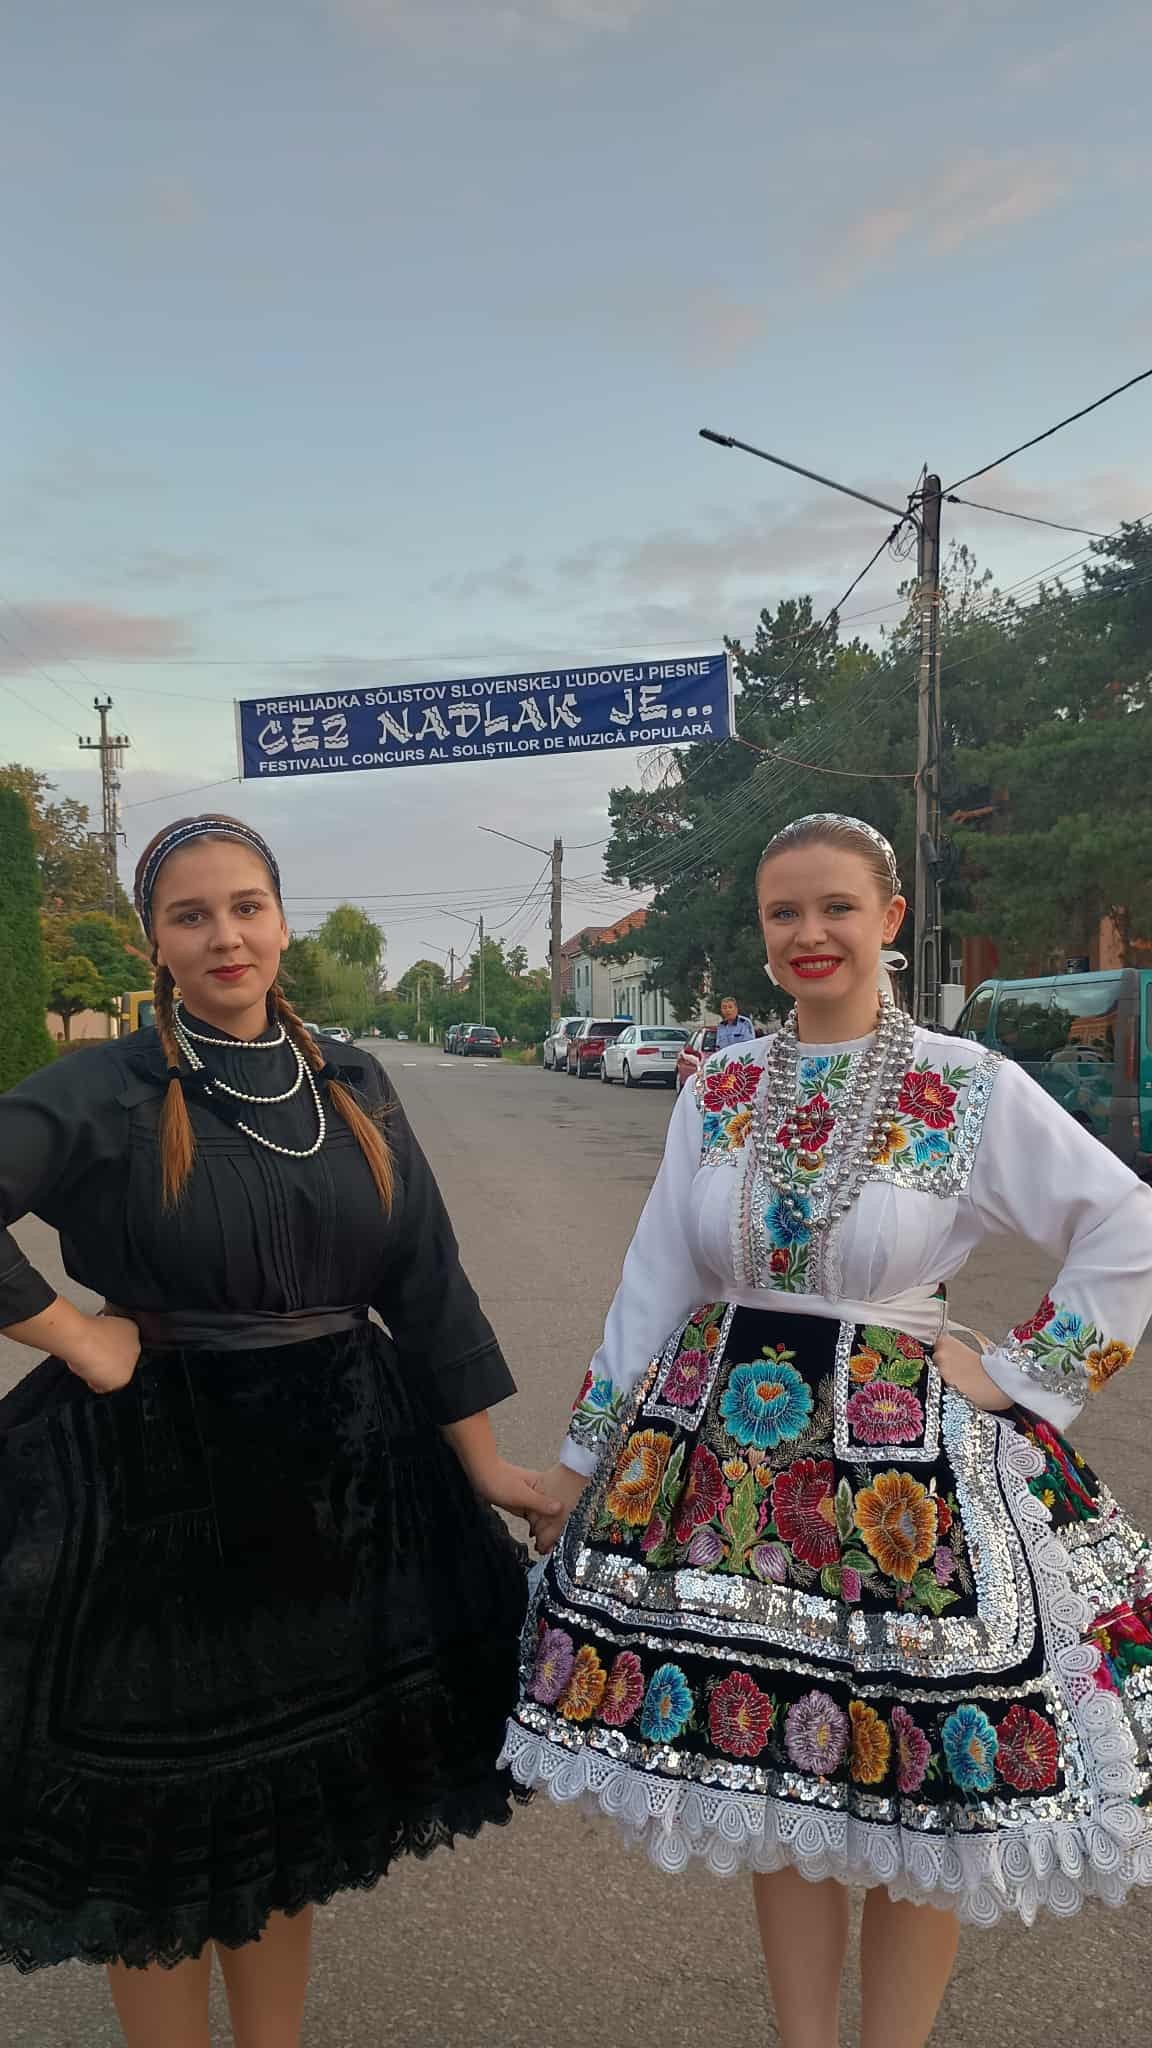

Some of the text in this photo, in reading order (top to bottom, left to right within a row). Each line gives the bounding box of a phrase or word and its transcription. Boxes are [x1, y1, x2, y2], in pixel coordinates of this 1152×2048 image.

[256, 694, 360, 716] PREHLIADKA
[451, 674, 561, 698] SLOVENSKEJ
[649, 660, 711, 680] PIESNE
[377, 693, 582, 745] NADLAK
[609, 684, 713, 726] JE...
[259, 754, 348, 773] FESTIVALUL
[352, 748, 425, 766] CONCURS
[429, 746, 448, 759] AL
[544, 736, 564, 750] DE
[568, 728, 626, 747] MUZICĂ
[629, 721, 713, 741] POPULARĂ
